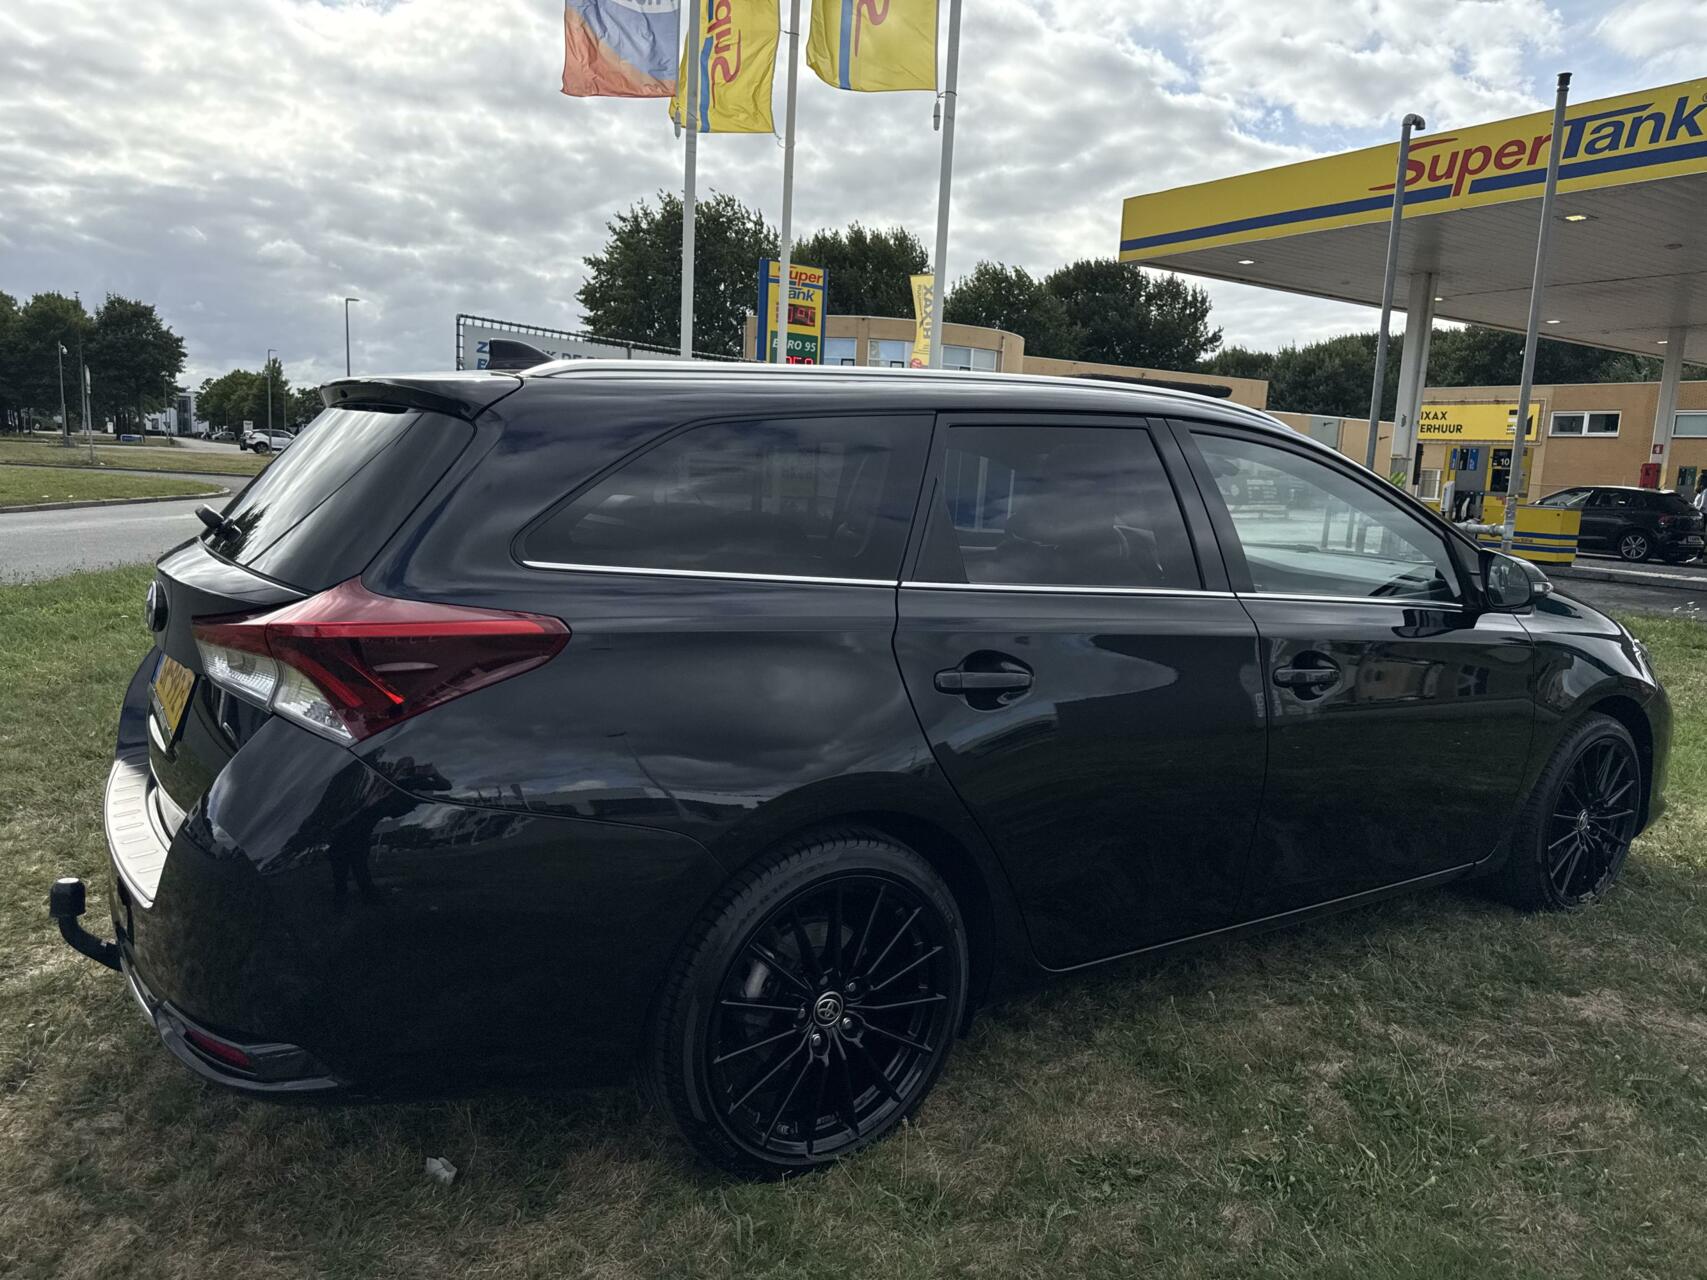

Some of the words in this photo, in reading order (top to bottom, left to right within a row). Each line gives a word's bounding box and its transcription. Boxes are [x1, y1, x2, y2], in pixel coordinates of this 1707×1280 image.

[1368, 137, 1552, 197] Super
[1550, 96, 1707, 159] Tank
[779, 266, 823, 286] uper
[784, 287, 815, 302] ank
[772, 338, 802, 350] ERO
[805, 342, 816, 352] 95
[1420, 411, 1448, 421] IXAX
[1420, 424, 1463, 434] ERHUUR
